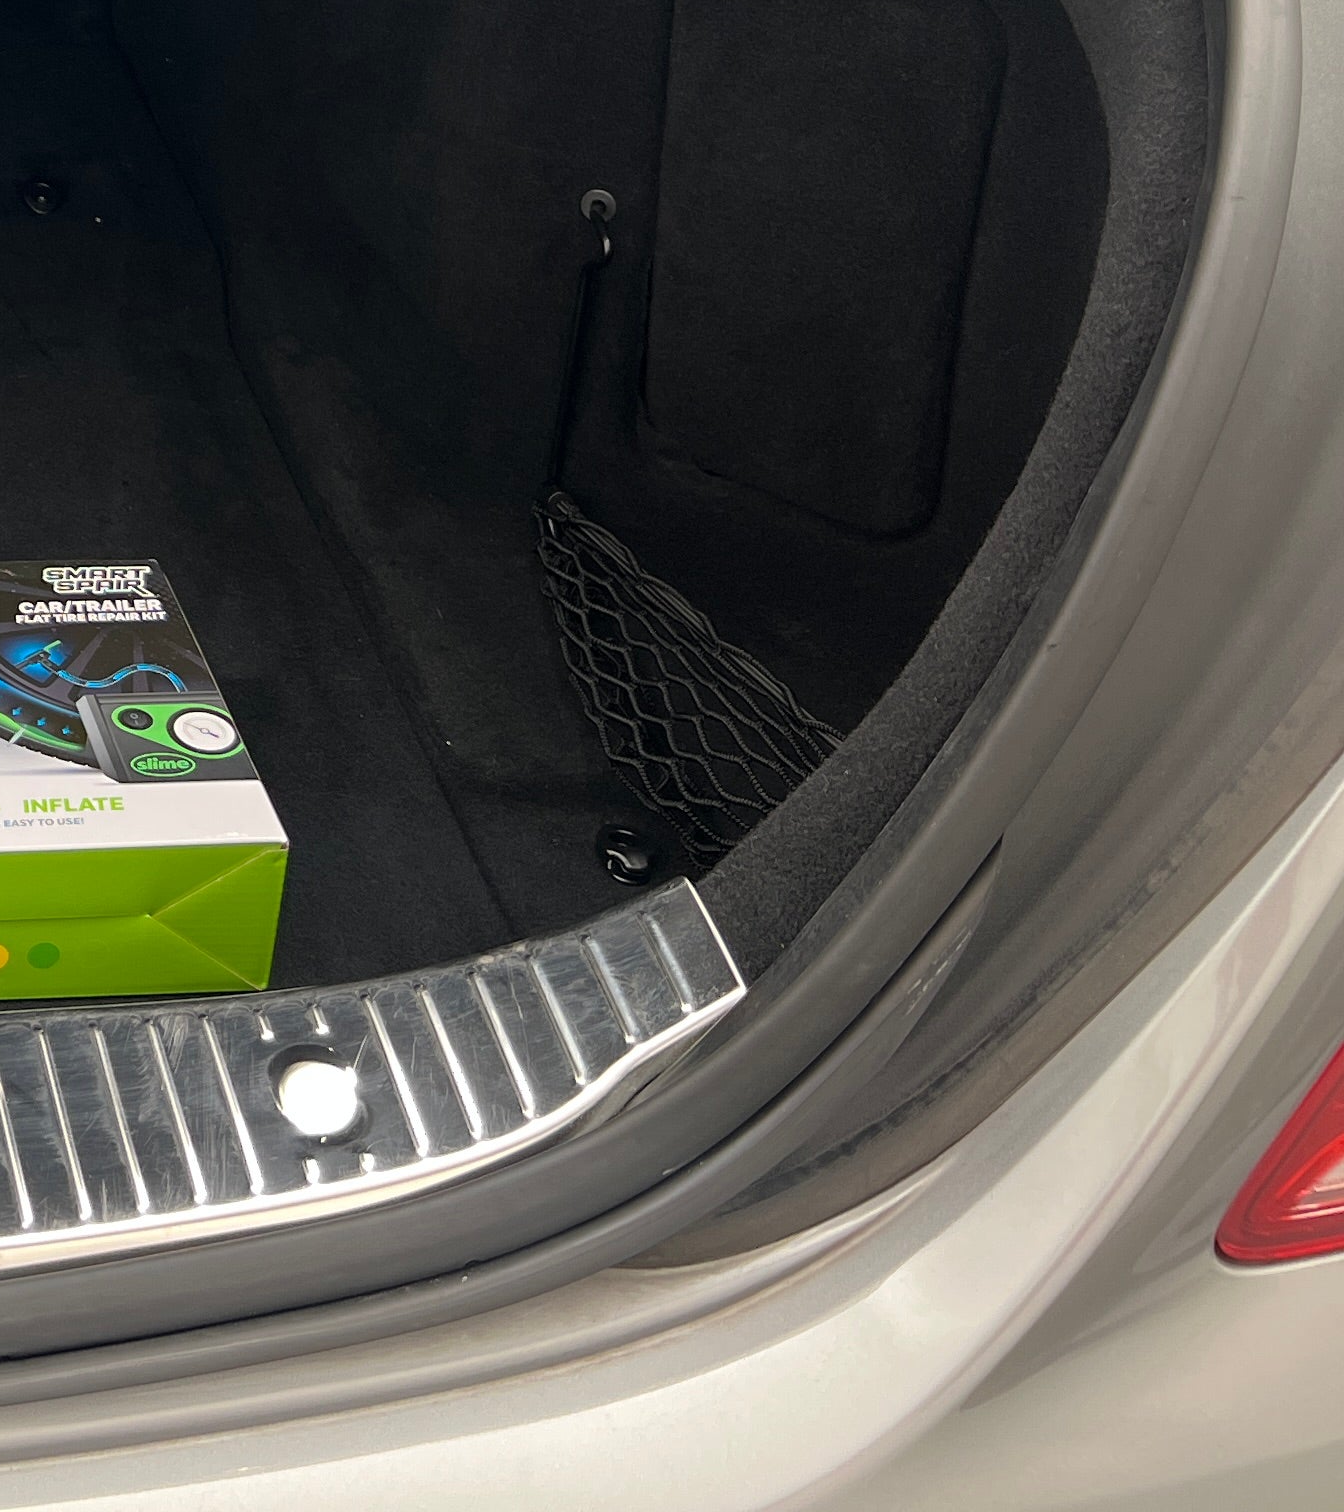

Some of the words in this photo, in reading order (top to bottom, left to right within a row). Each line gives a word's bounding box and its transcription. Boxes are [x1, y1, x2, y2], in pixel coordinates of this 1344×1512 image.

[42, 566, 150, 580] SMART
[53, 578, 155, 597] SPAIR
[18, 599, 162, 614] CAR/TRAILER
[15, 614, 51, 624] FLAT
[53, 613, 87, 623] TIRE
[88, 612, 140, 622] REPAIR
[141, 611, 167, 620] KIT
[136, 757, 190, 771] slime
[23, 797, 125, 813] INFLATE
[3, 819, 34, 828] EASY
[38, 819, 55, 827] TO
[57, 817, 85, 826] USE!
